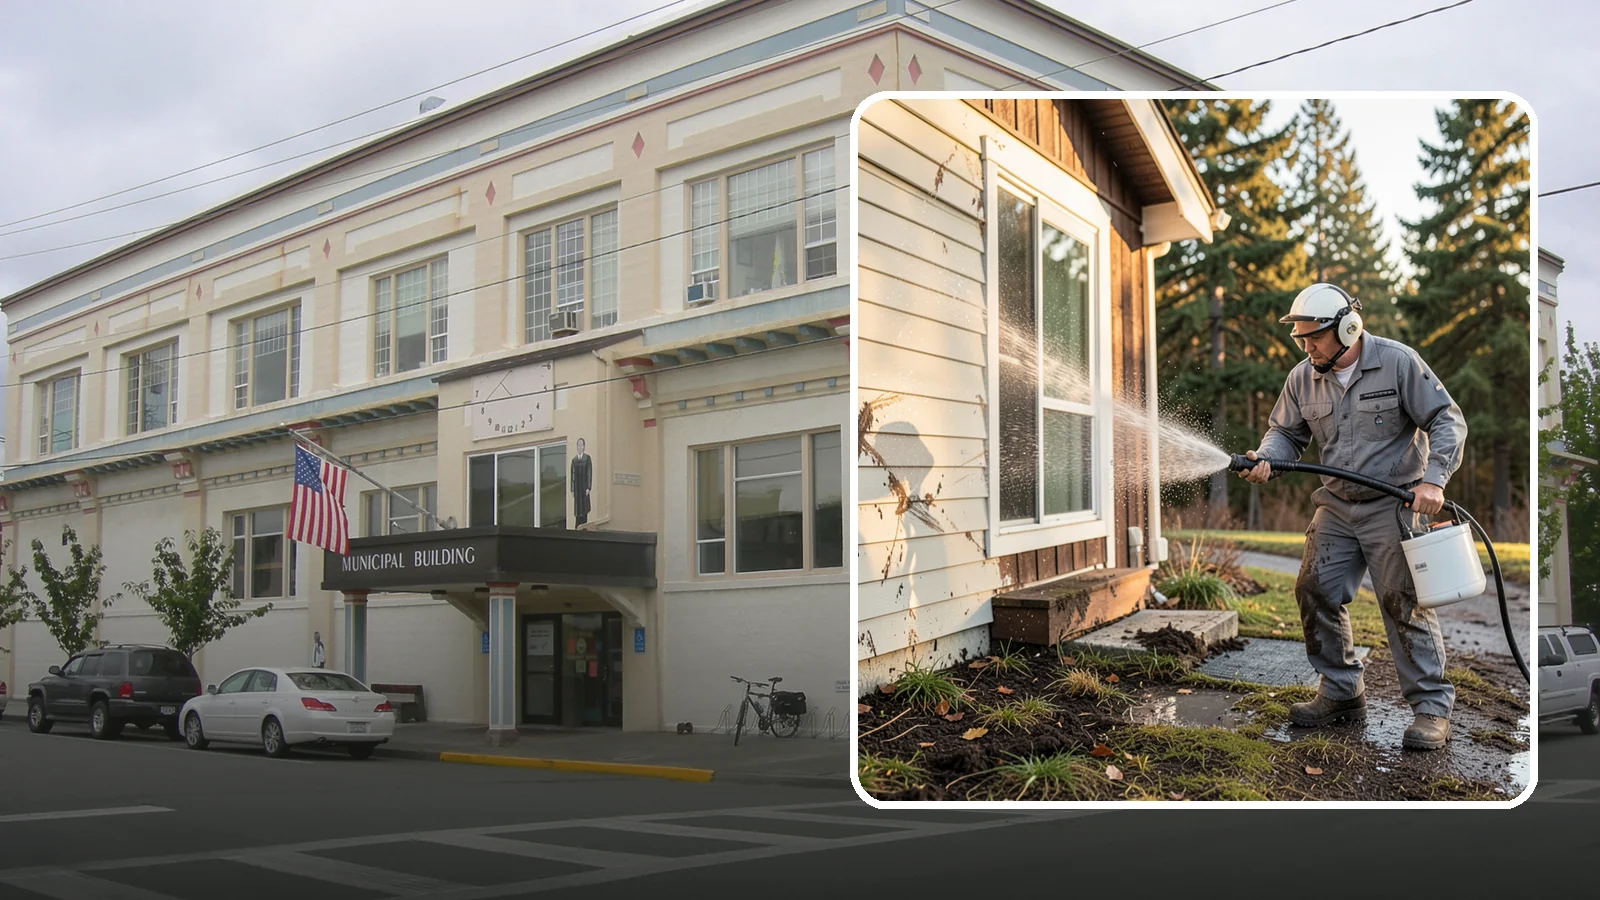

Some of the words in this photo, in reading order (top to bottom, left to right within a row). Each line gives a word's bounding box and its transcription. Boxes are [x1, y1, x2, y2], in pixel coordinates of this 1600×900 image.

[475, 390, 479, 398] 7
[481, 407, 485, 415] 8
[488, 417, 492, 425] 9
[494, 423, 500, 432] 10
[507, 425, 513, 433] 12
[521, 420, 526, 428] 2
[529, 414, 533, 422] 3
[536, 402, 540, 410] 4
[547, 361, 552, 370] 6
[342, 552, 405, 572] MUNICIPAL
[414, 546, 475, 567] BUILDING
